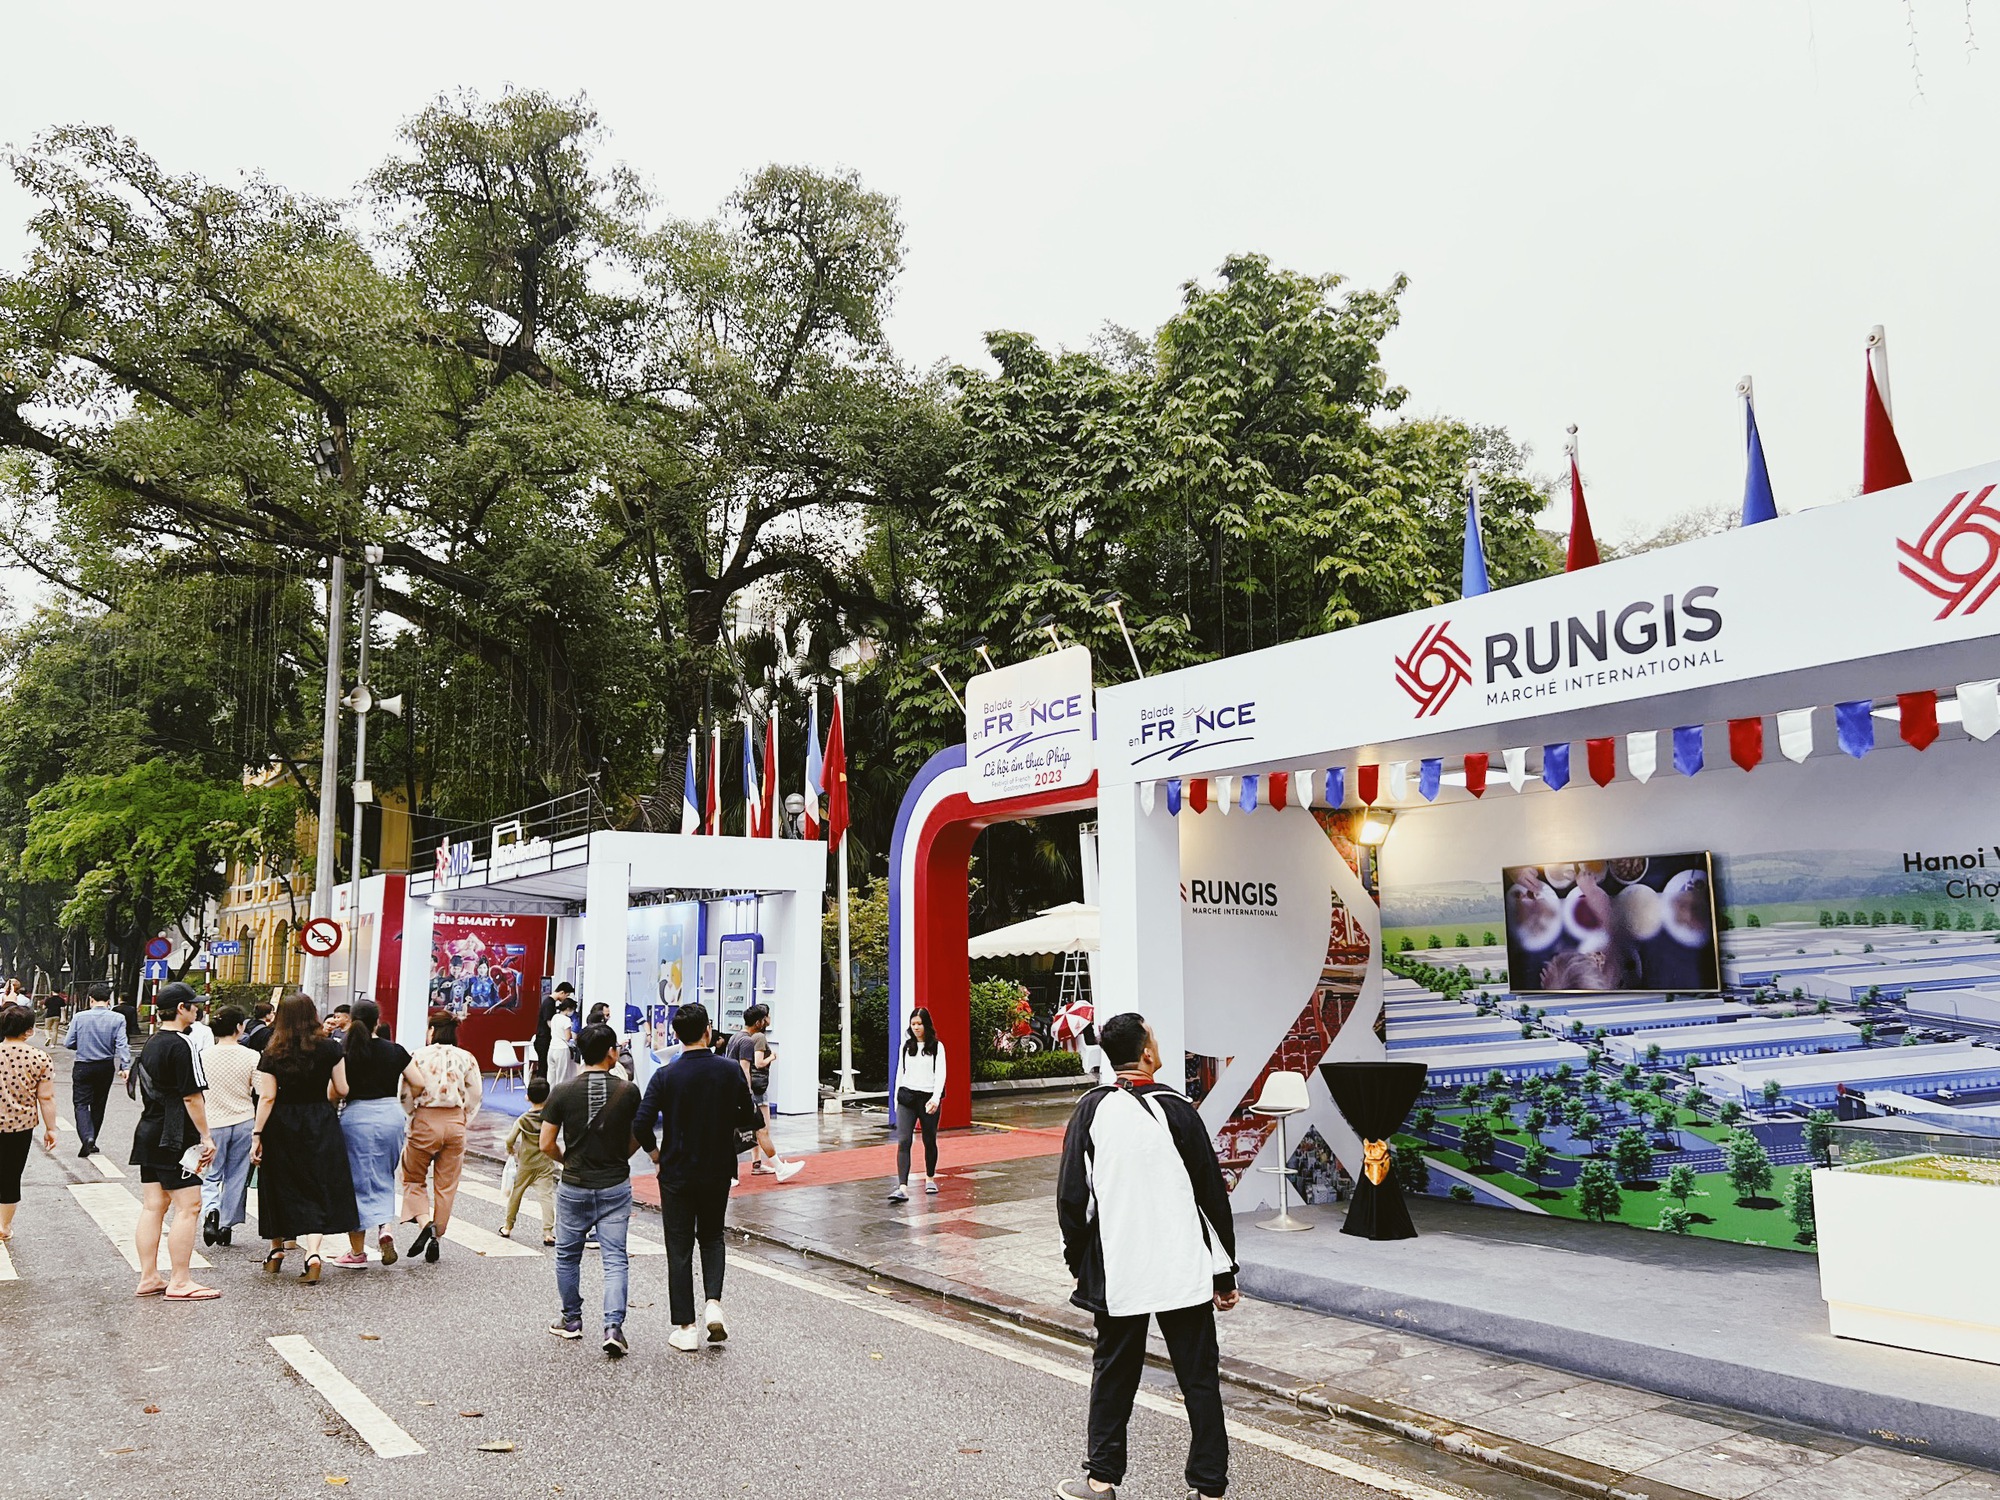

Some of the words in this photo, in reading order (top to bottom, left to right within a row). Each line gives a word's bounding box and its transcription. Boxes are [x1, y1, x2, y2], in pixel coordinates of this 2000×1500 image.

[1485, 585, 1722, 684] RUNGIS
[1486, 679, 1557, 706] MARCHÉ
[1565, 649, 1724, 692] INTERNATIONAL
[983, 697, 1013, 714] Balade
[1140, 704, 1174, 720] Balade
[972, 731, 982, 740] en
[1128, 737, 1139, 747] en
[1047, 747, 1071, 769] Pháp
[1034, 769, 1062, 786] 2023
[449, 840, 473, 876] MB
[1903, 847, 1985, 873] Hanoi
[1191, 879, 1278, 907] RUNGIS
[1192, 907, 1221, 915] MARCHÉ
[1223, 908, 1278, 917] INTERNATIONAL
[457, 917, 498, 927] SMART
[500, 918, 516, 927] TV
